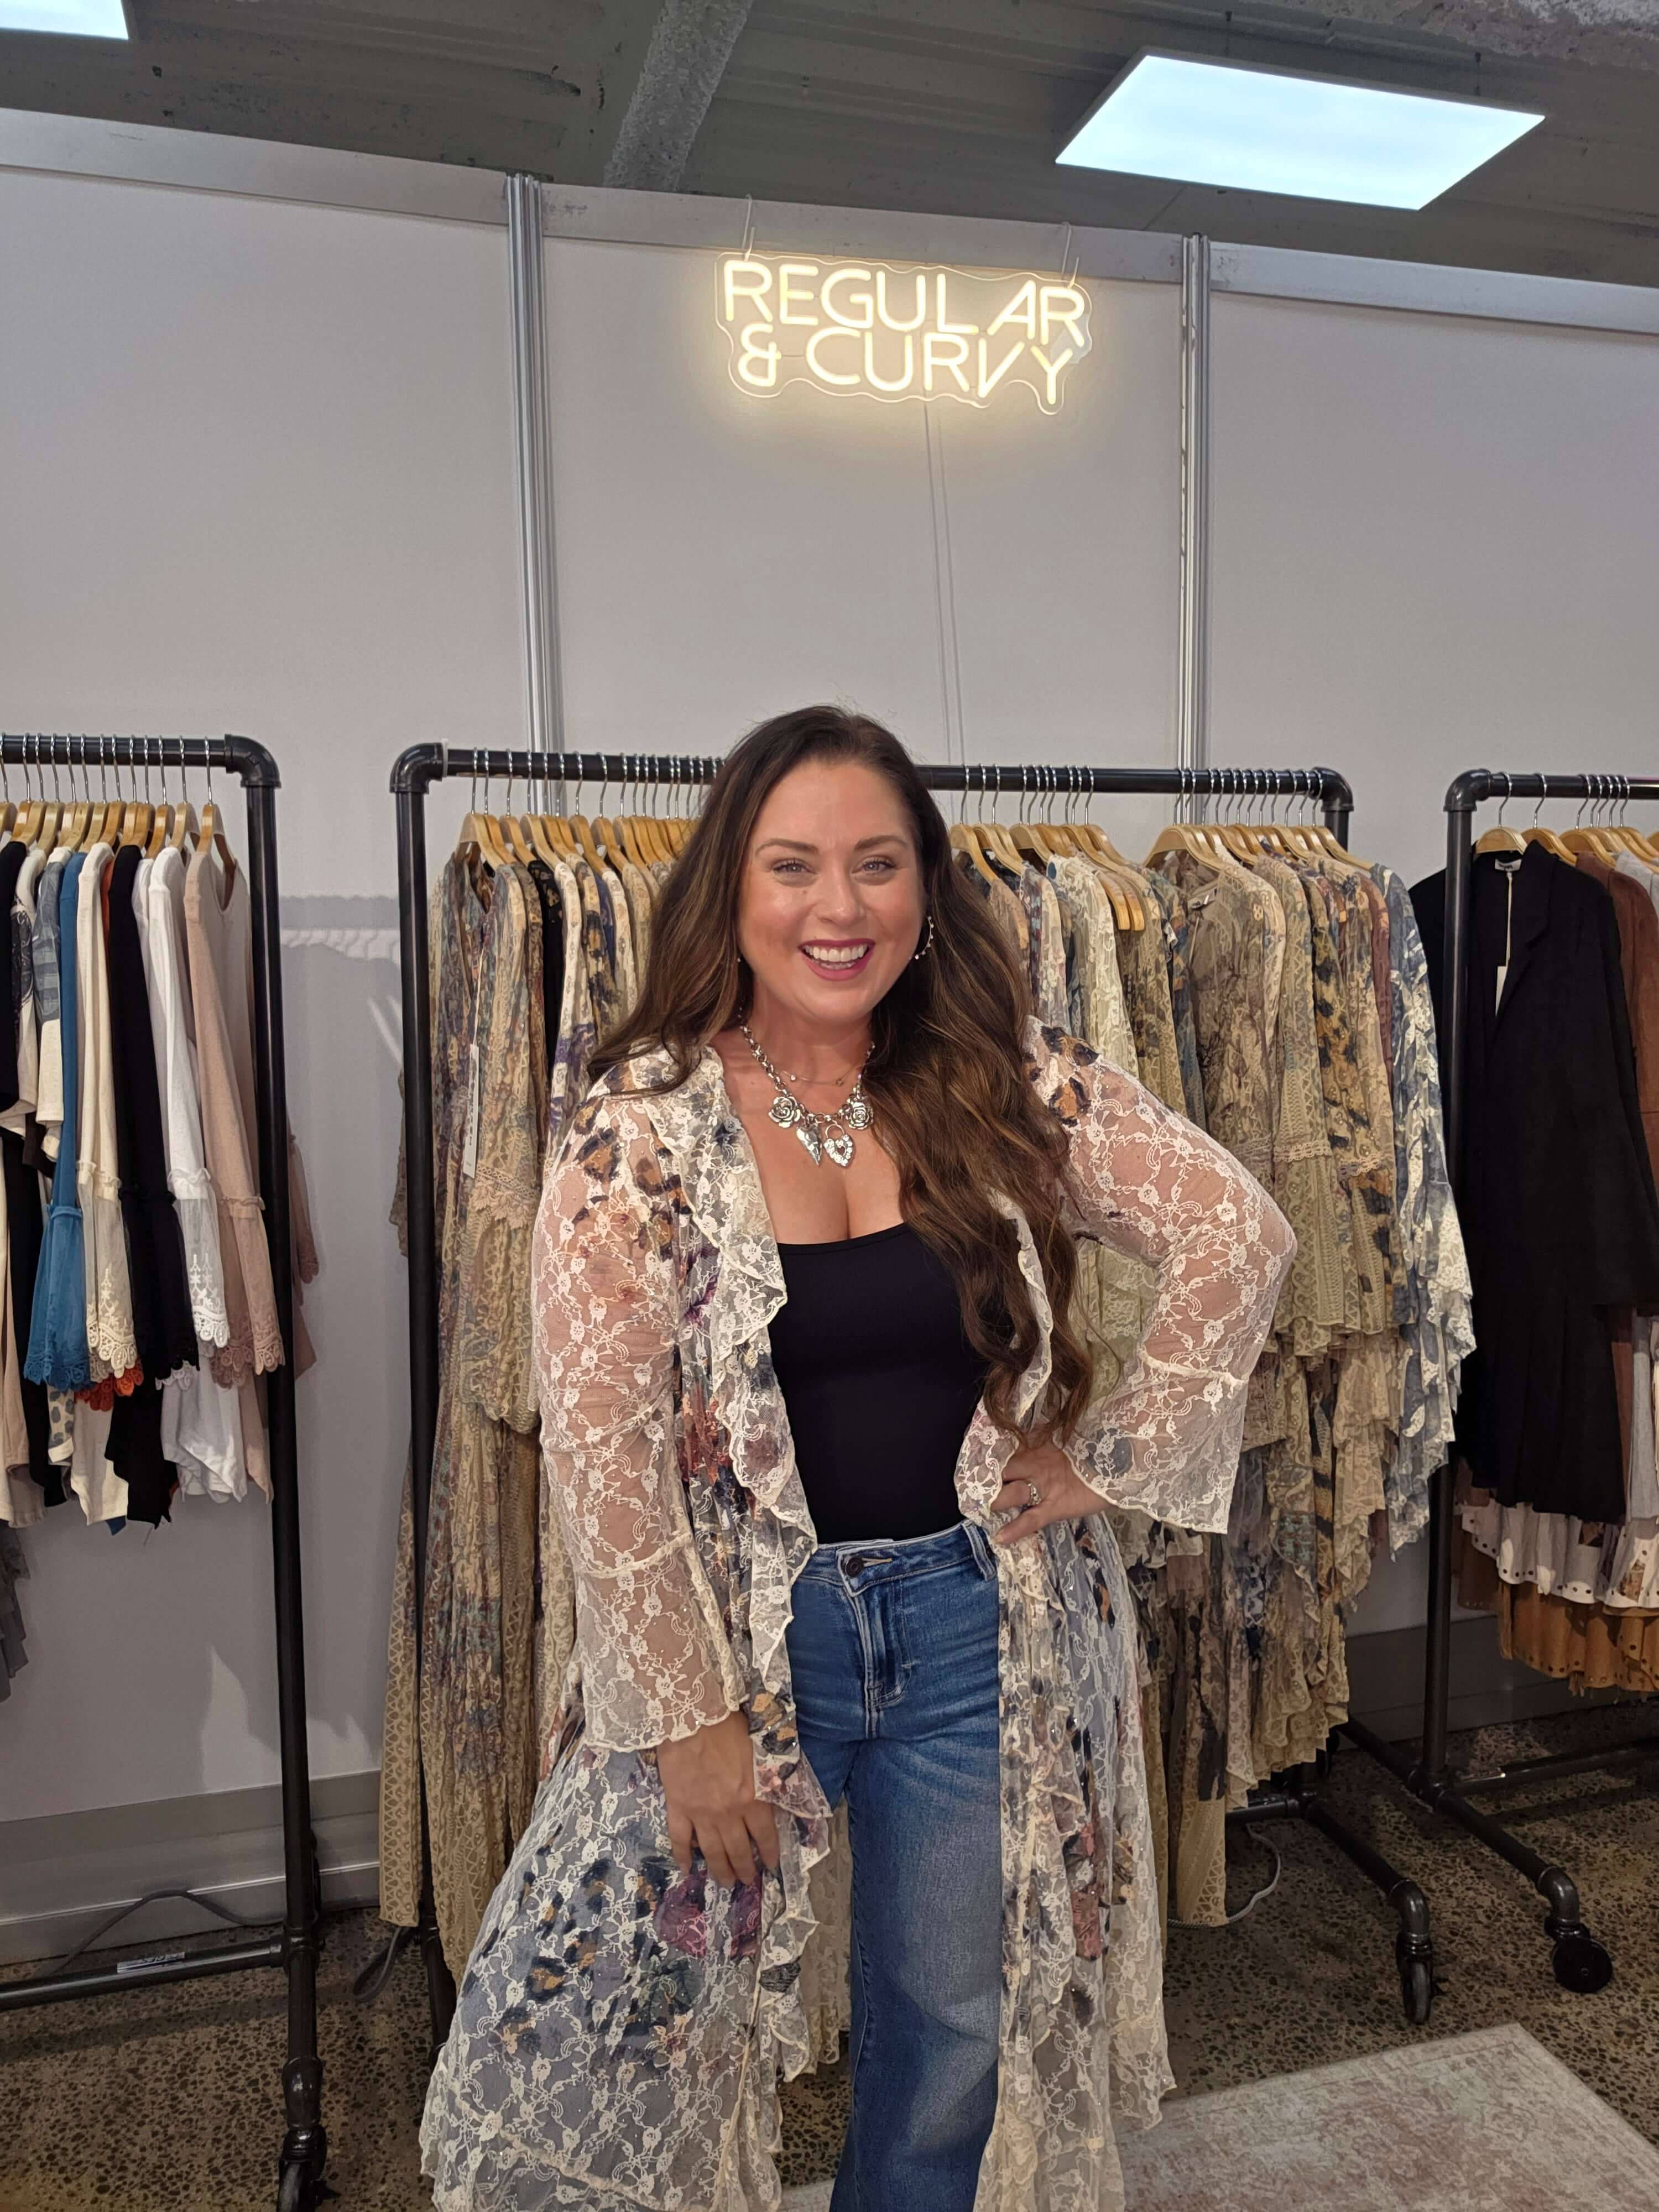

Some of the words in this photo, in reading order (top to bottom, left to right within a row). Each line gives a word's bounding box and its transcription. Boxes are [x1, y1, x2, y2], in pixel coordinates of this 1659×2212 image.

[723, 259, 1085, 347] REGULAR
[737, 323, 782, 387] &
[805, 326, 1073, 405] CURVY
